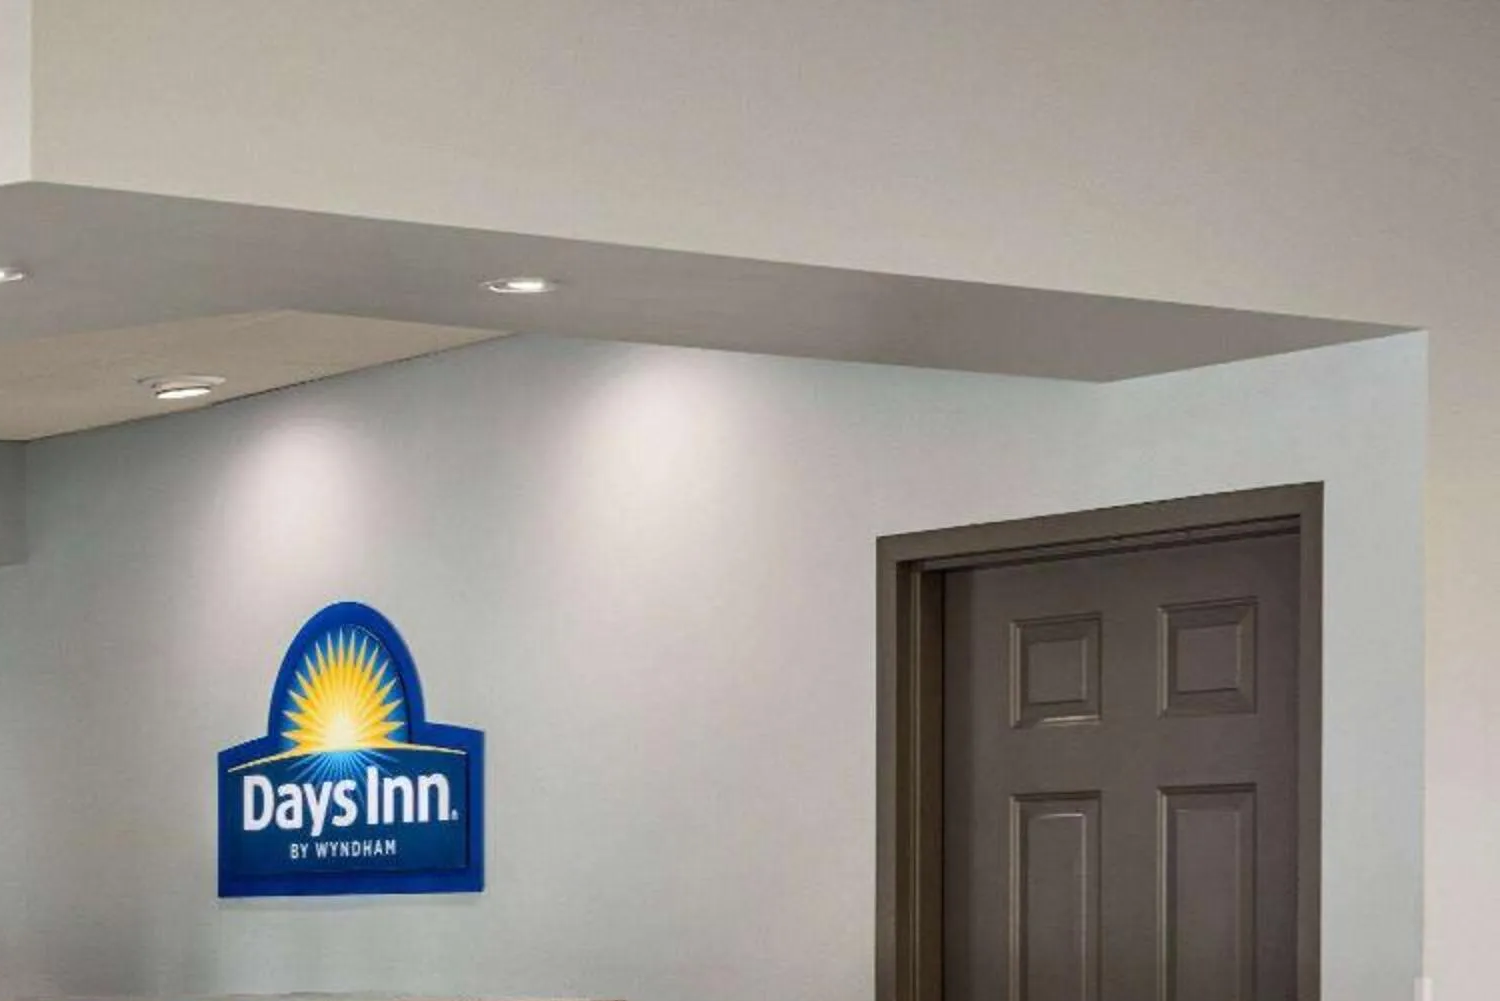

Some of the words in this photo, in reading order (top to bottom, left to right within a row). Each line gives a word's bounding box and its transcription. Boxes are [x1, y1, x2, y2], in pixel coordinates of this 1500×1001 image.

[243, 775, 356, 837] Days
[367, 766, 450, 825] Inn
[290, 843, 308, 859] BY
[316, 839, 396, 857] WYNDHAM
